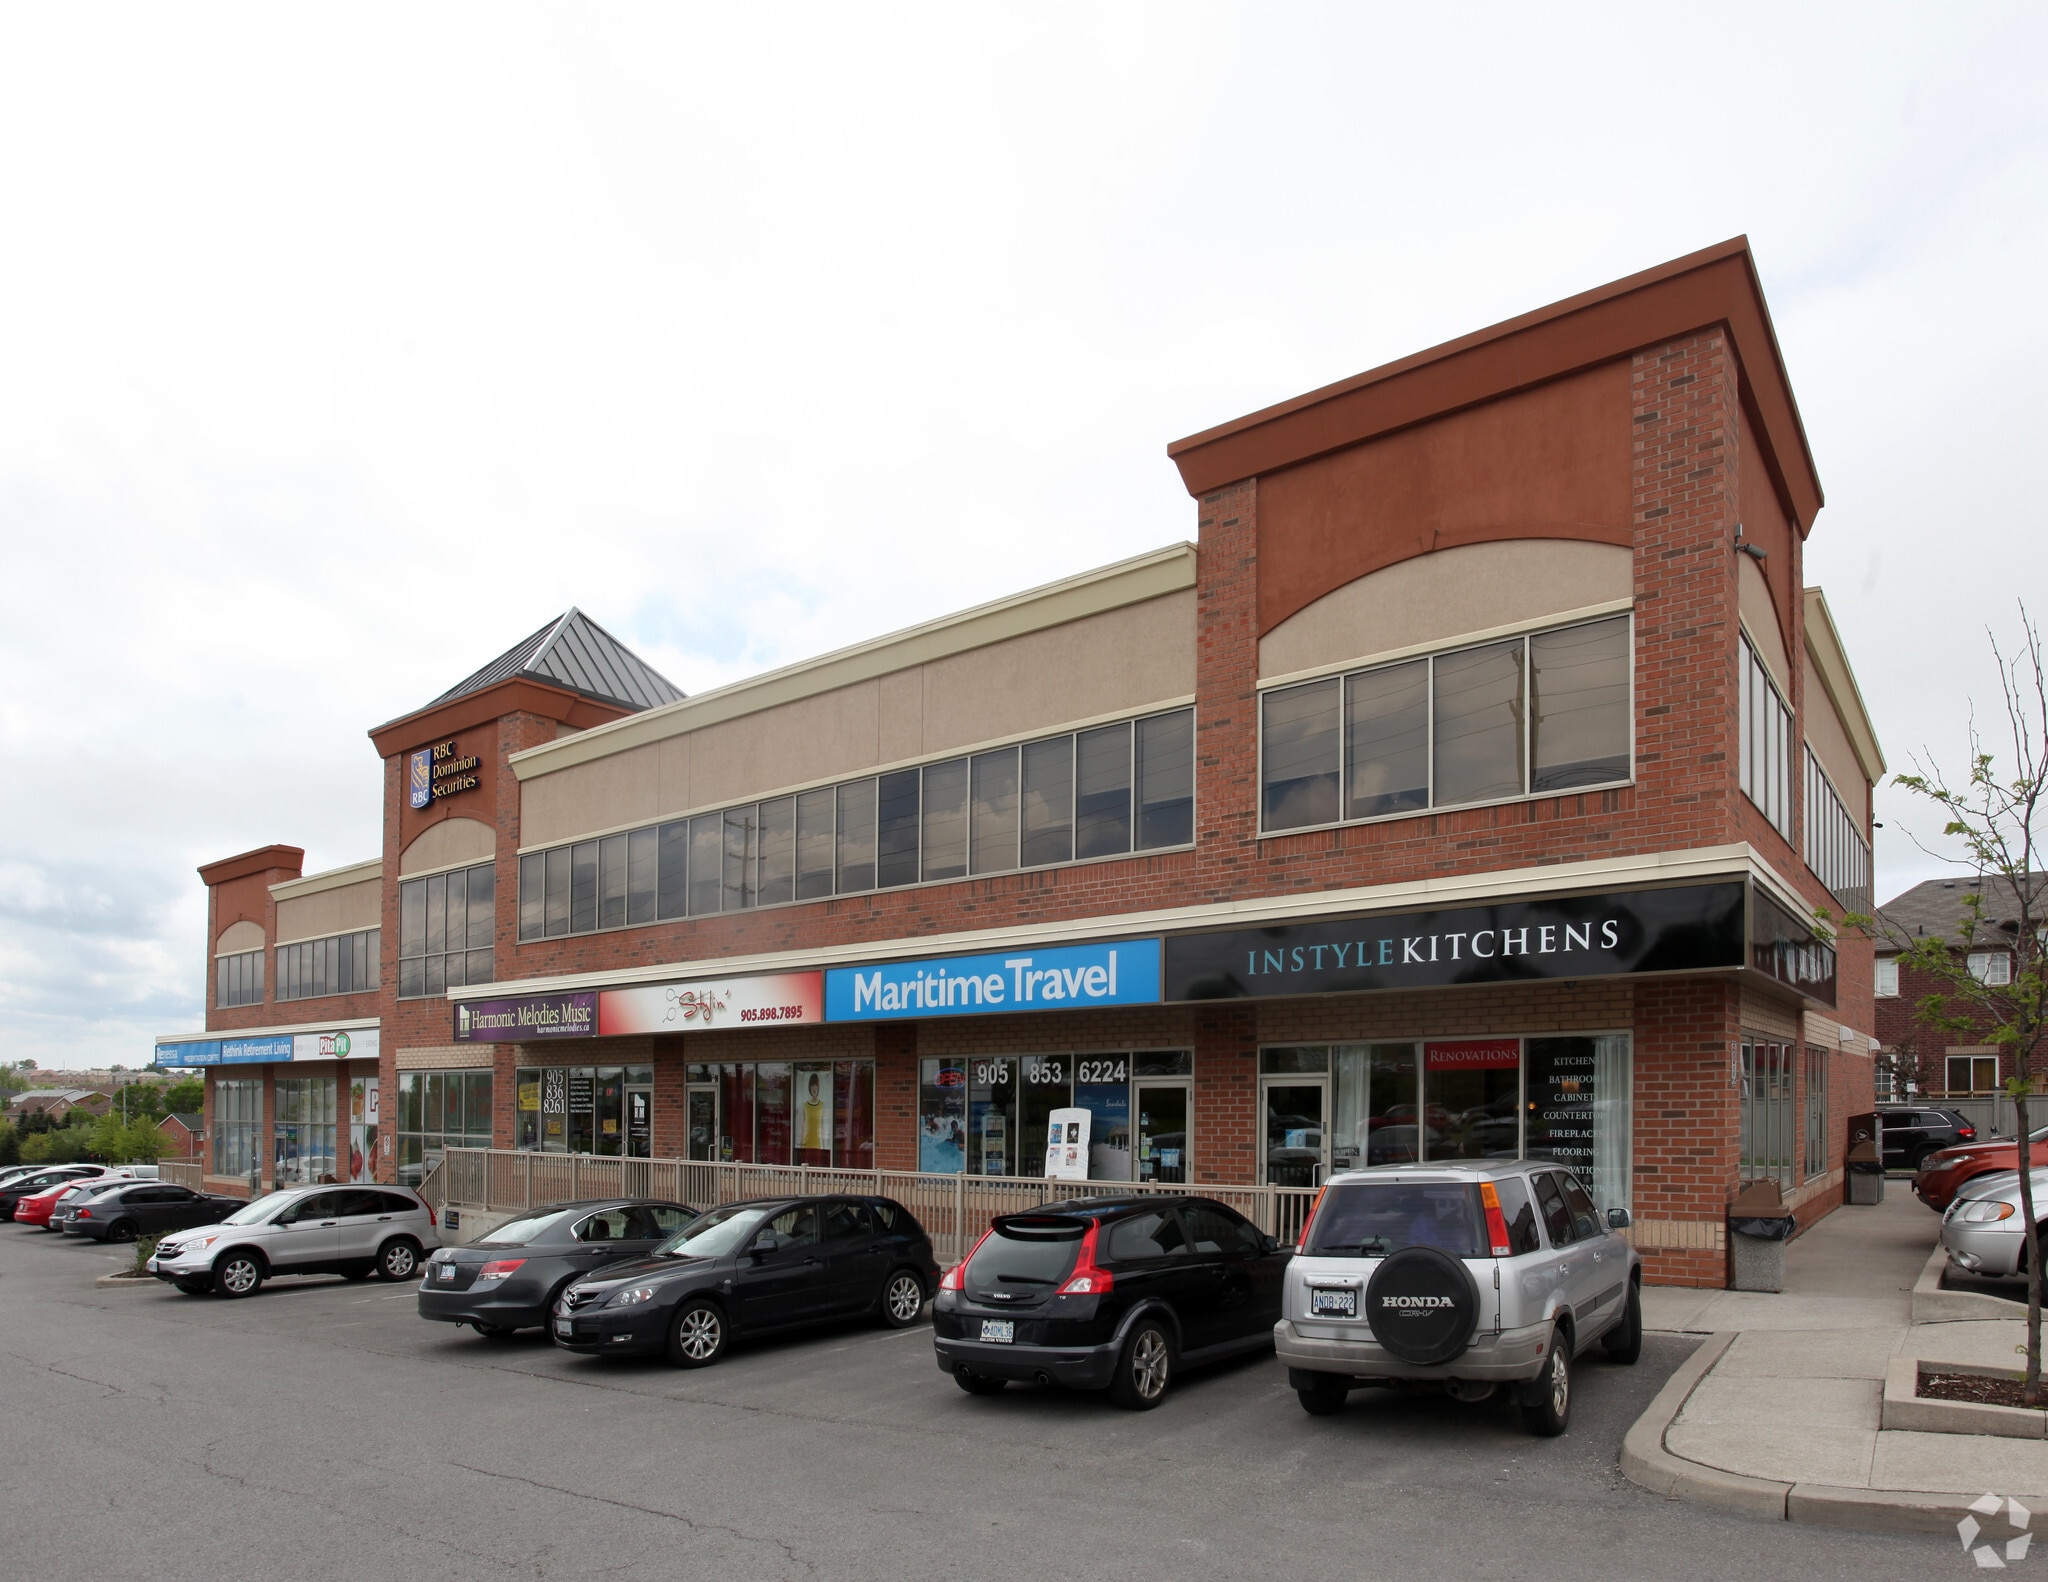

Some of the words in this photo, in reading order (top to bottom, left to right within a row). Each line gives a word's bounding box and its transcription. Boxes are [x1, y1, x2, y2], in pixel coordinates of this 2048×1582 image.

[433, 741, 453, 760] RBC
[433, 756, 477, 779] Dominion
[432, 774, 476, 798] Securities
[412, 789, 428, 804] RBC
[854, 968, 1005, 1012] Maritime
[1005, 950, 1117, 1002] Travel
[471, 1009, 516, 1029] Harmonic
[517, 1004, 560, 1026] Melodies
[561, 1002, 591, 1023] Music
[740, 1005, 803, 1022] 905.898.7895
[536, 1024, 590, 1034] harmonicmelodies.ca
[223, 1045, 243, 1057] Rethink
[243, 1044, 274, 1056] Retirement
[274, 1042, 291, 1057] Living
[320, 1037, 335, 1055] Pita
[335, 1037, 347, 1053] Pit
[546, 1069, 564, 1085] 905
[935, 1073, 966, 1086] OPEN
[977, 1063, 1009, 1085] 905
[1029, 1062, 1063, 1084] 853
[1079, 1060, 1126, 1083] 6224
[546, 1085, 564, 1099] 836
[543, 1099, 566, 1114] 8261
[1336, 1147, 1359, 1157] OPEN
[1552, 1147, 1600, 1157] FLOORING
[1382, 1296, 1455, 1308] HONDA
[1399, 1309, 1434, 1317] CR-V
